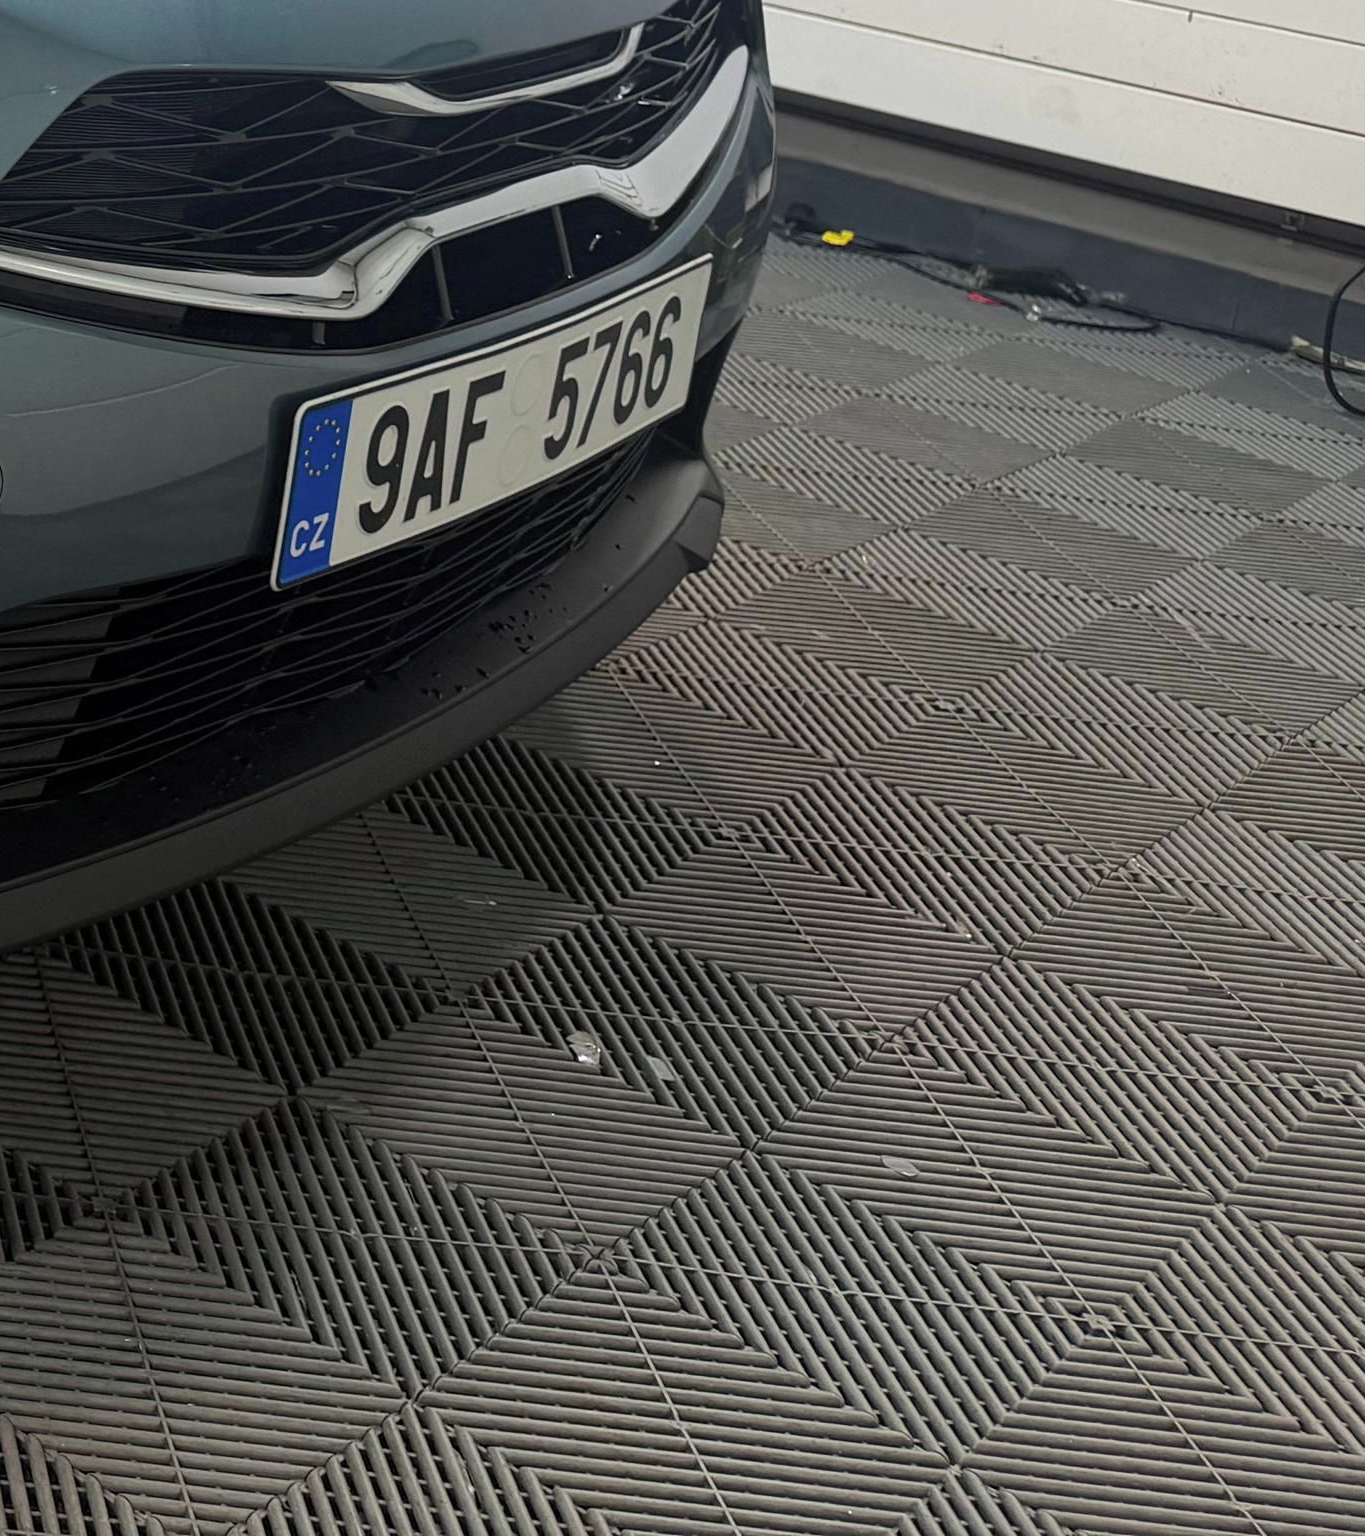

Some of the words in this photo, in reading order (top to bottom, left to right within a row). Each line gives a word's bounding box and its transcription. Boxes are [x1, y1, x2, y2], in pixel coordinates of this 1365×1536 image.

[358, 370, 506, 535] 9AF
[543, 295, 682, 460] 5766
[289, 512, 330, 559] CZ
